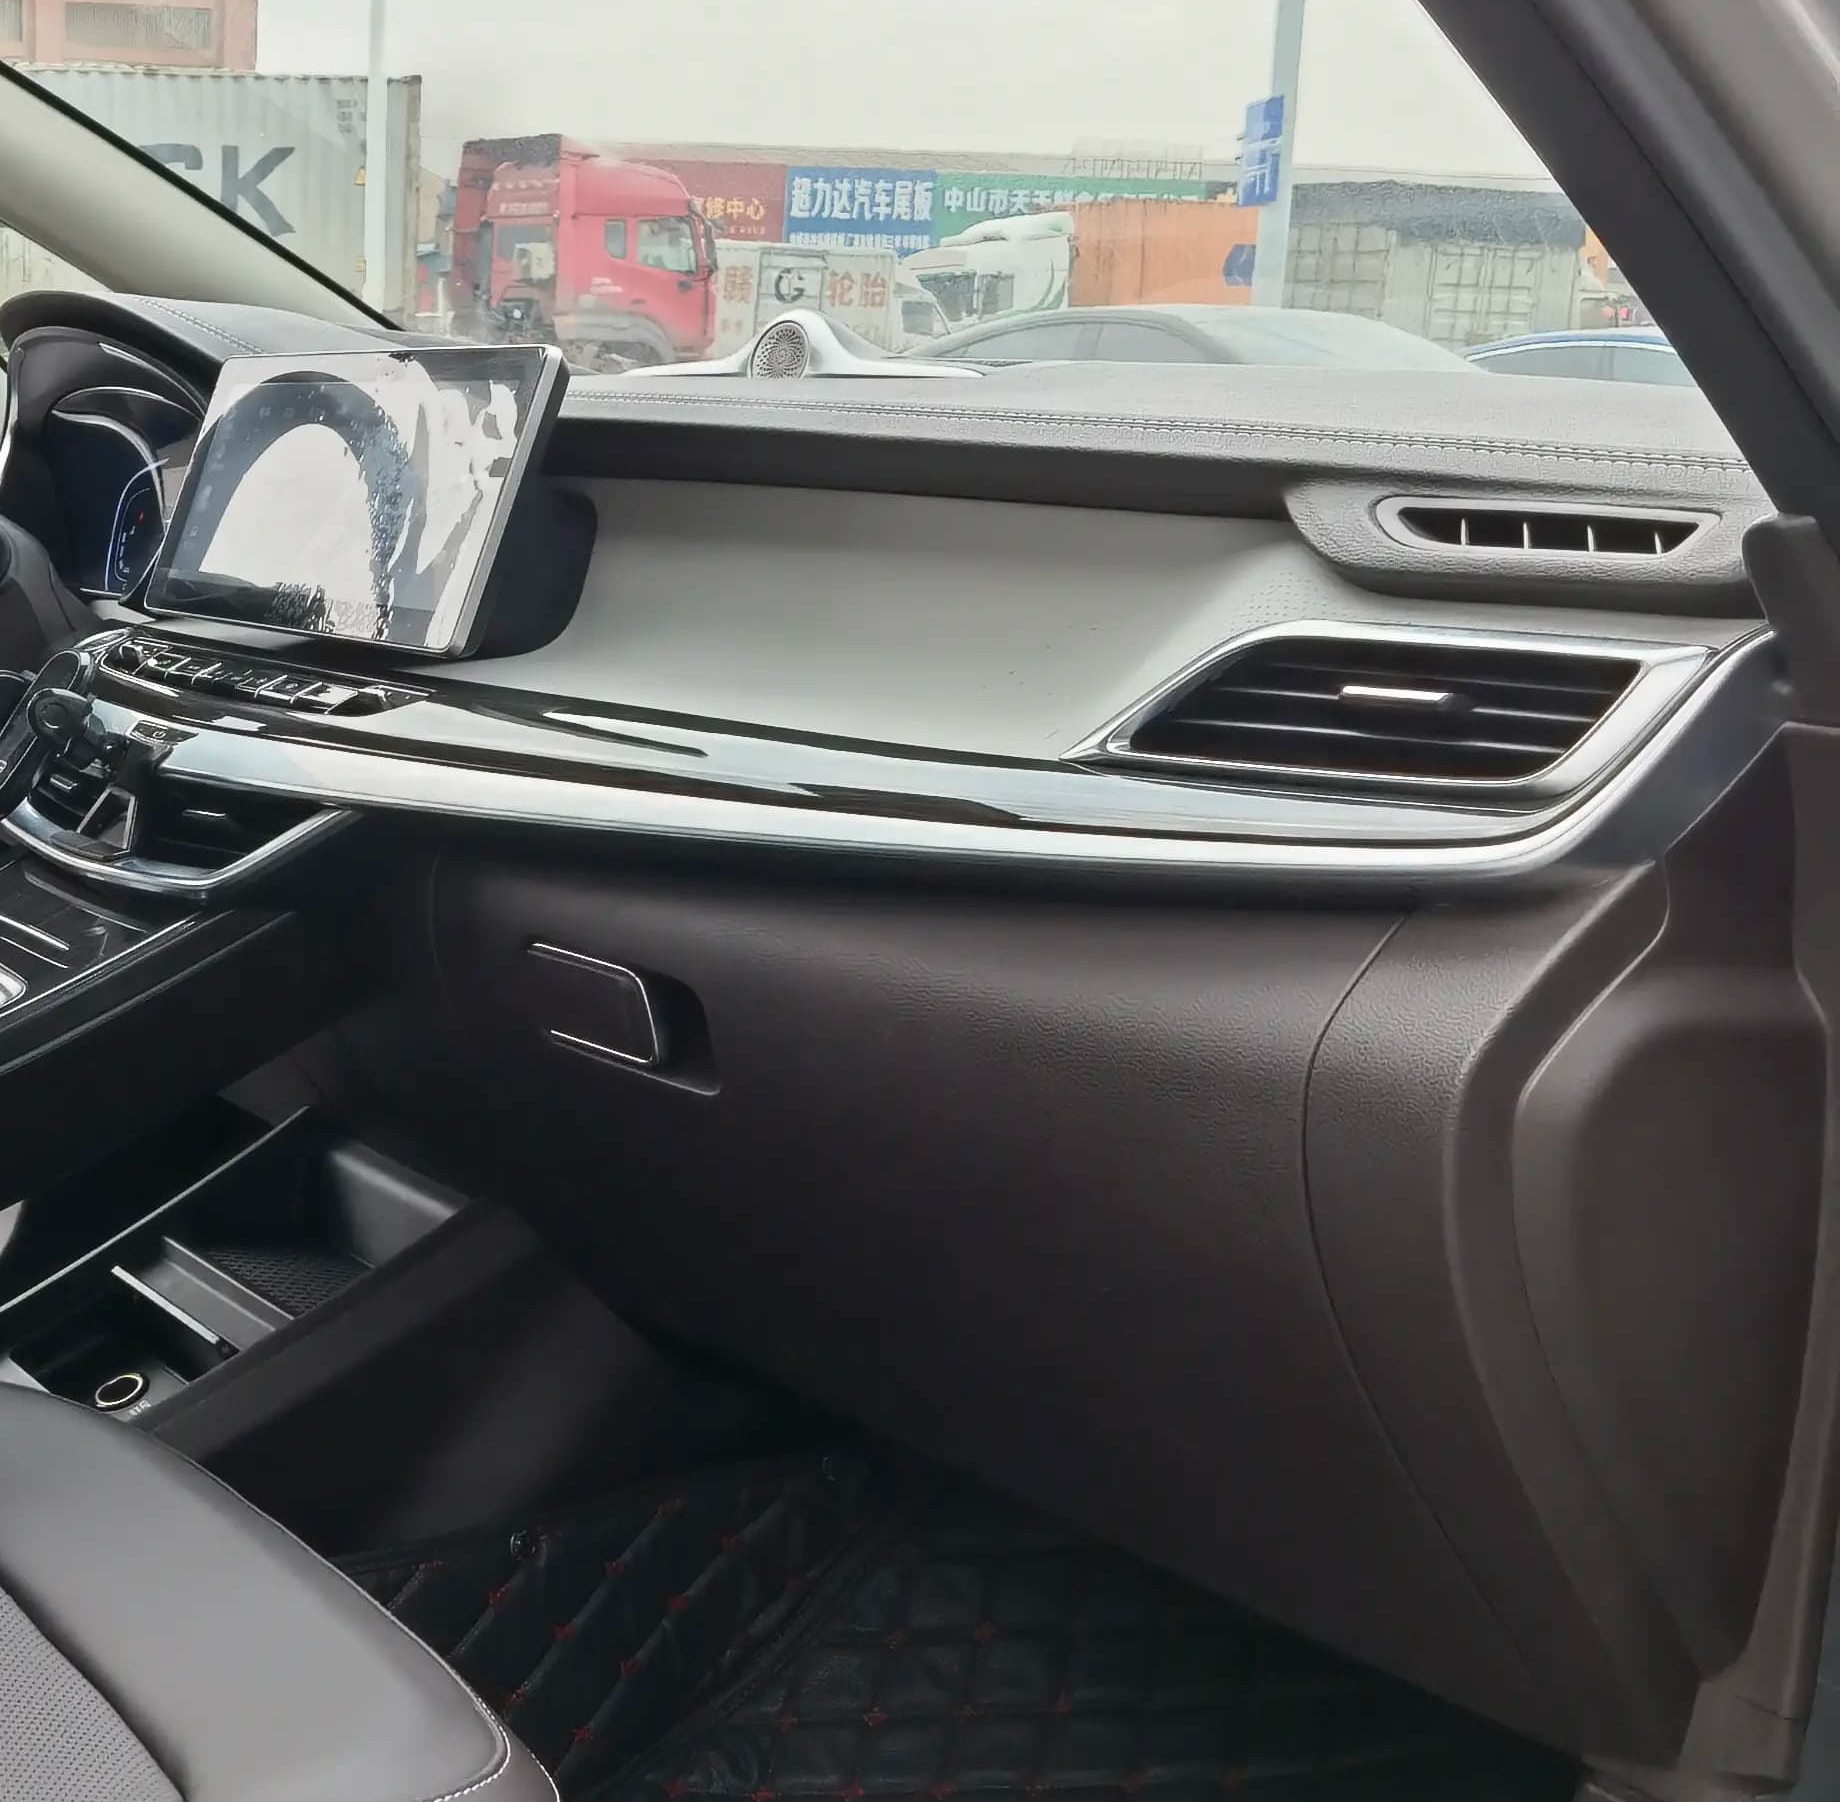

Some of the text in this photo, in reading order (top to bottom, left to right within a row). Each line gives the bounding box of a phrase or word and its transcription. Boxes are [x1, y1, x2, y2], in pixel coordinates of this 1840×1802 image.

[695, 196, 765, 221] 修中心
[827, 269, 888, 309] 轮胎
